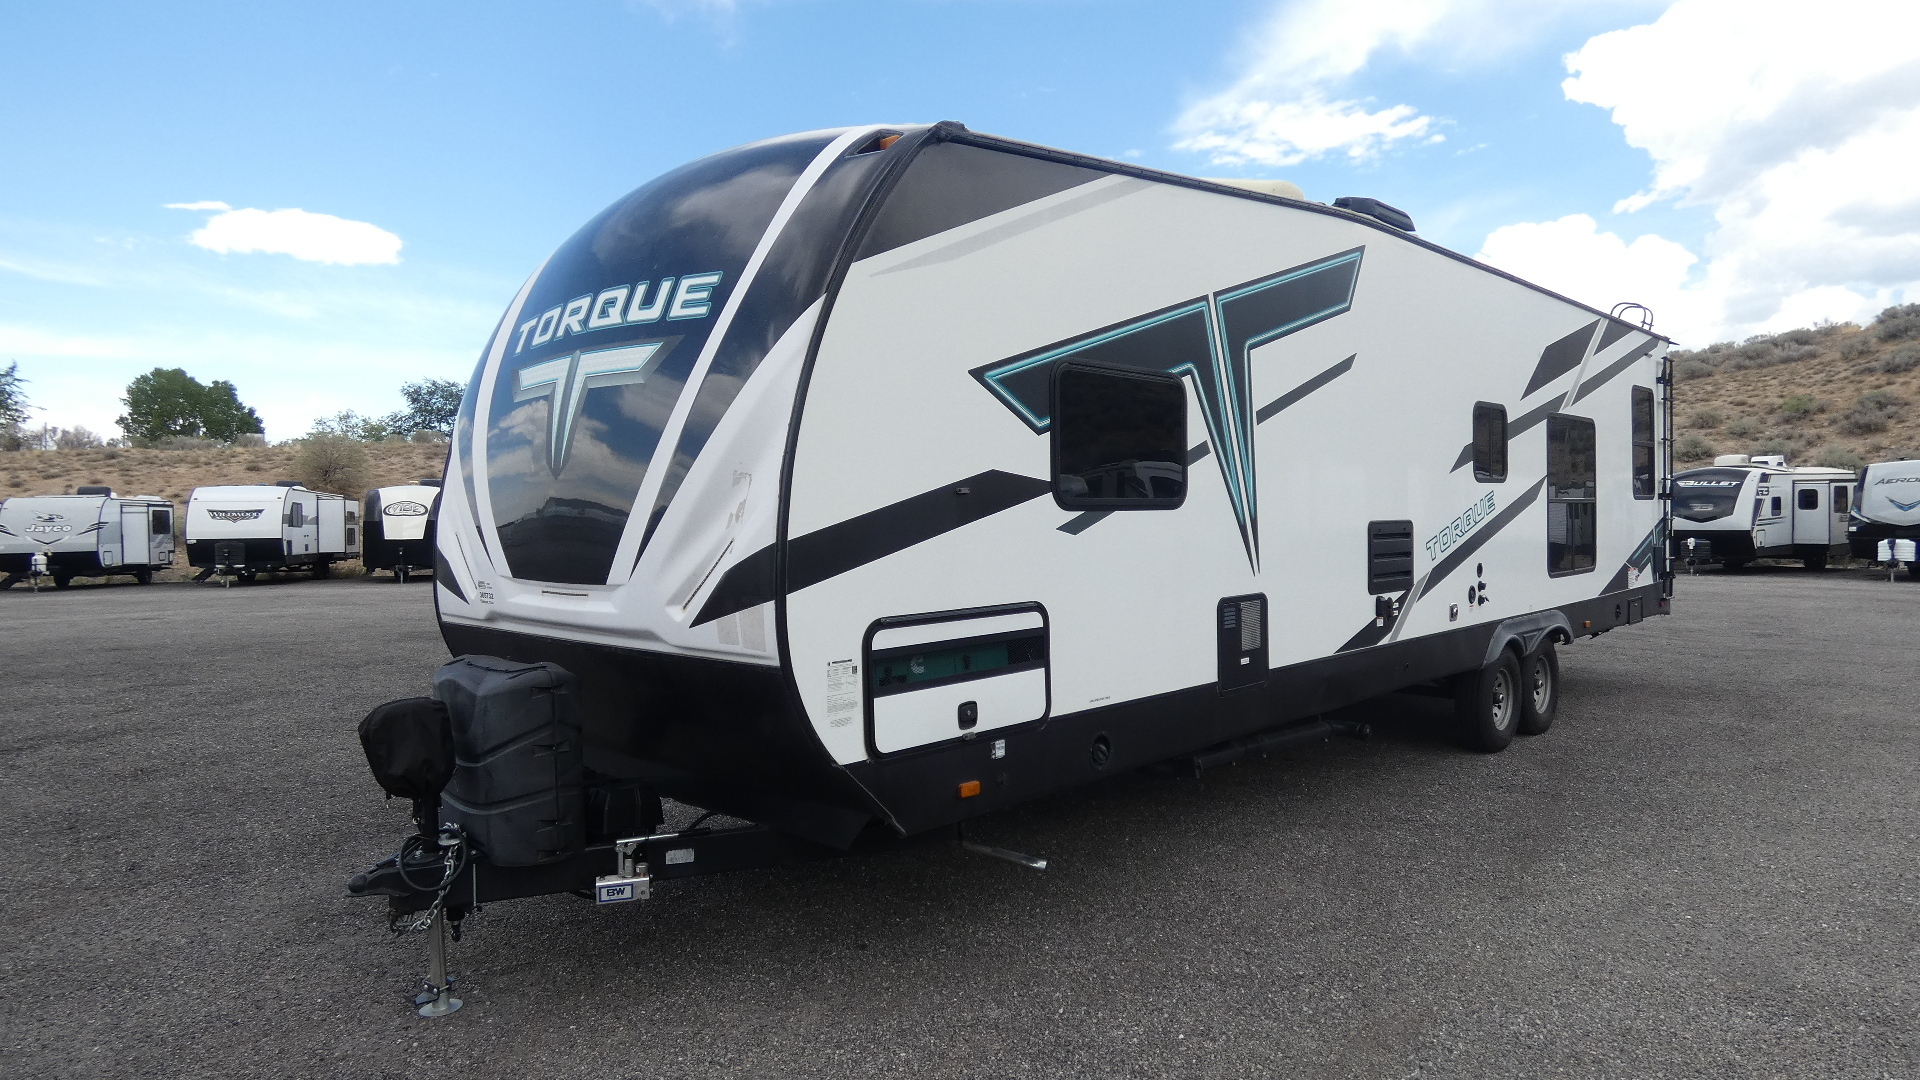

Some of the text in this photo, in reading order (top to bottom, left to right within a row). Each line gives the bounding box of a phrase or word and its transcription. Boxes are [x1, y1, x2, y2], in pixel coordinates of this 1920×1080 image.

[514, 271, 723, 357] TORQUE
[1874, 477, 1920, 486] AERO
[388, 503, 422, 513] VIBE
[25, 523, 72, 534] Jayco
[1426, 490, 1496, 561] TORQUE
